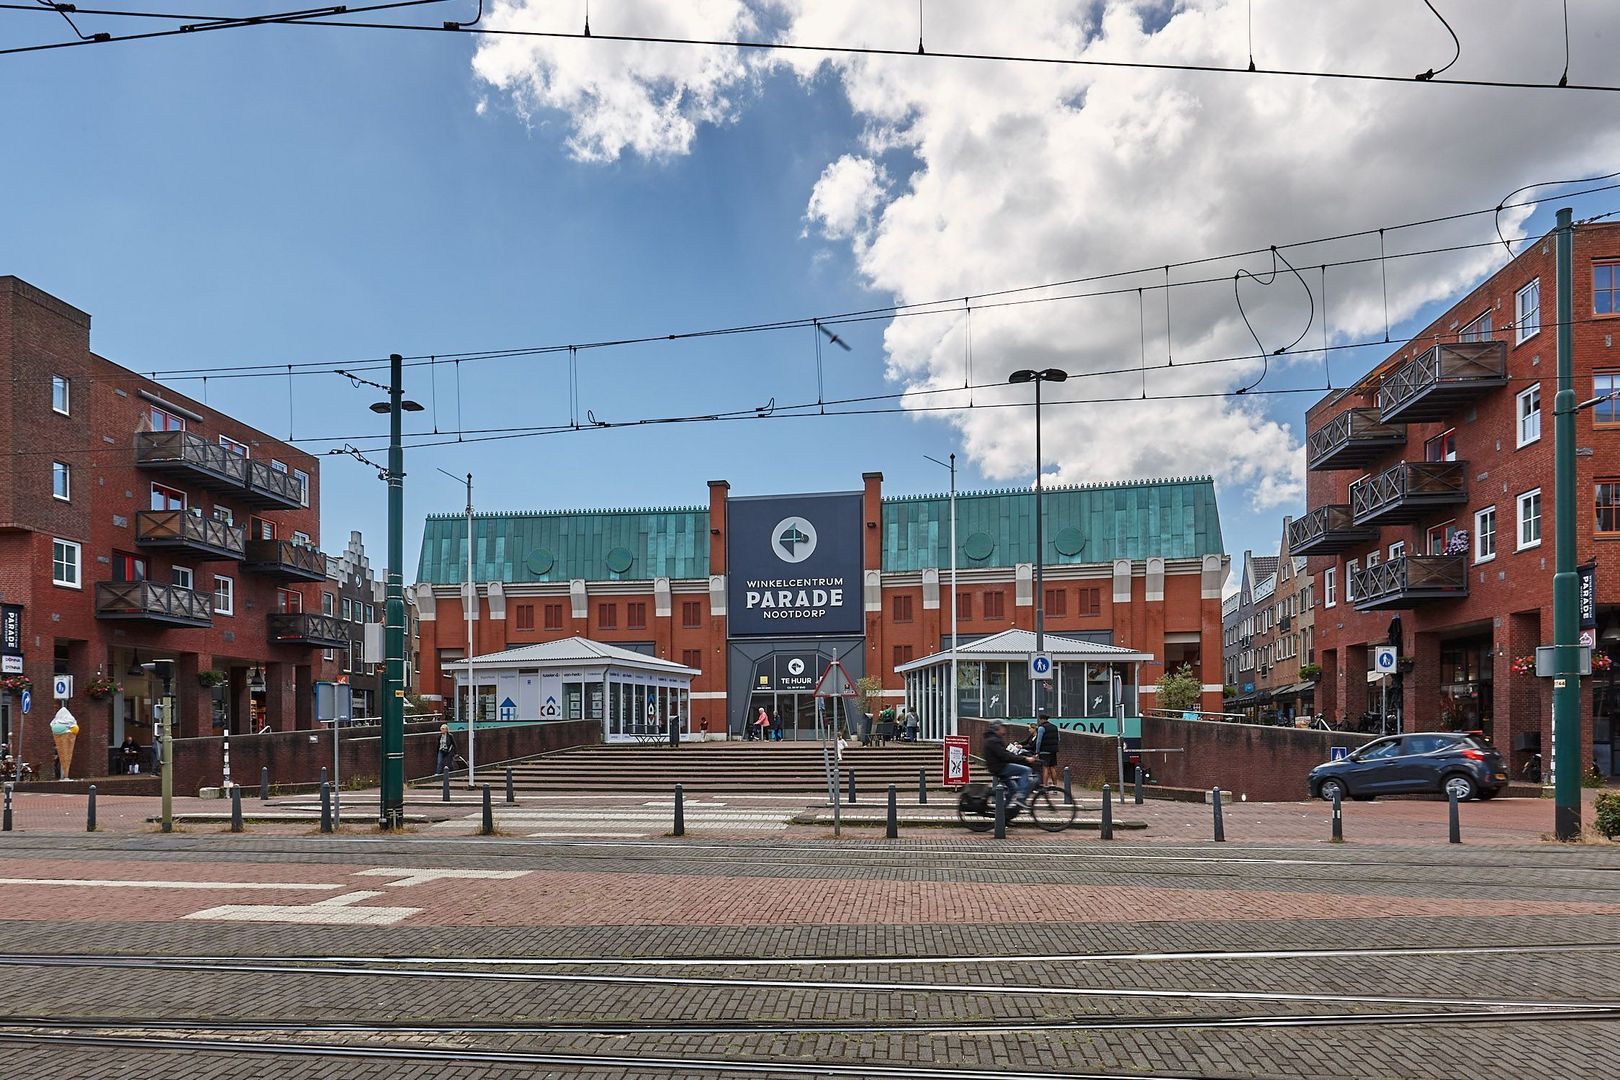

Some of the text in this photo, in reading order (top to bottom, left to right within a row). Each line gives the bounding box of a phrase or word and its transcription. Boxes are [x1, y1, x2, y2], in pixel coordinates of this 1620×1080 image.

[746, 577, 843, 588] WINKELCENTRUM
[746, 589, 844, 609] PARADE
[763, 609, 826, 619] NOOTDORP
[1059, 722, 1105, 734] KOM
